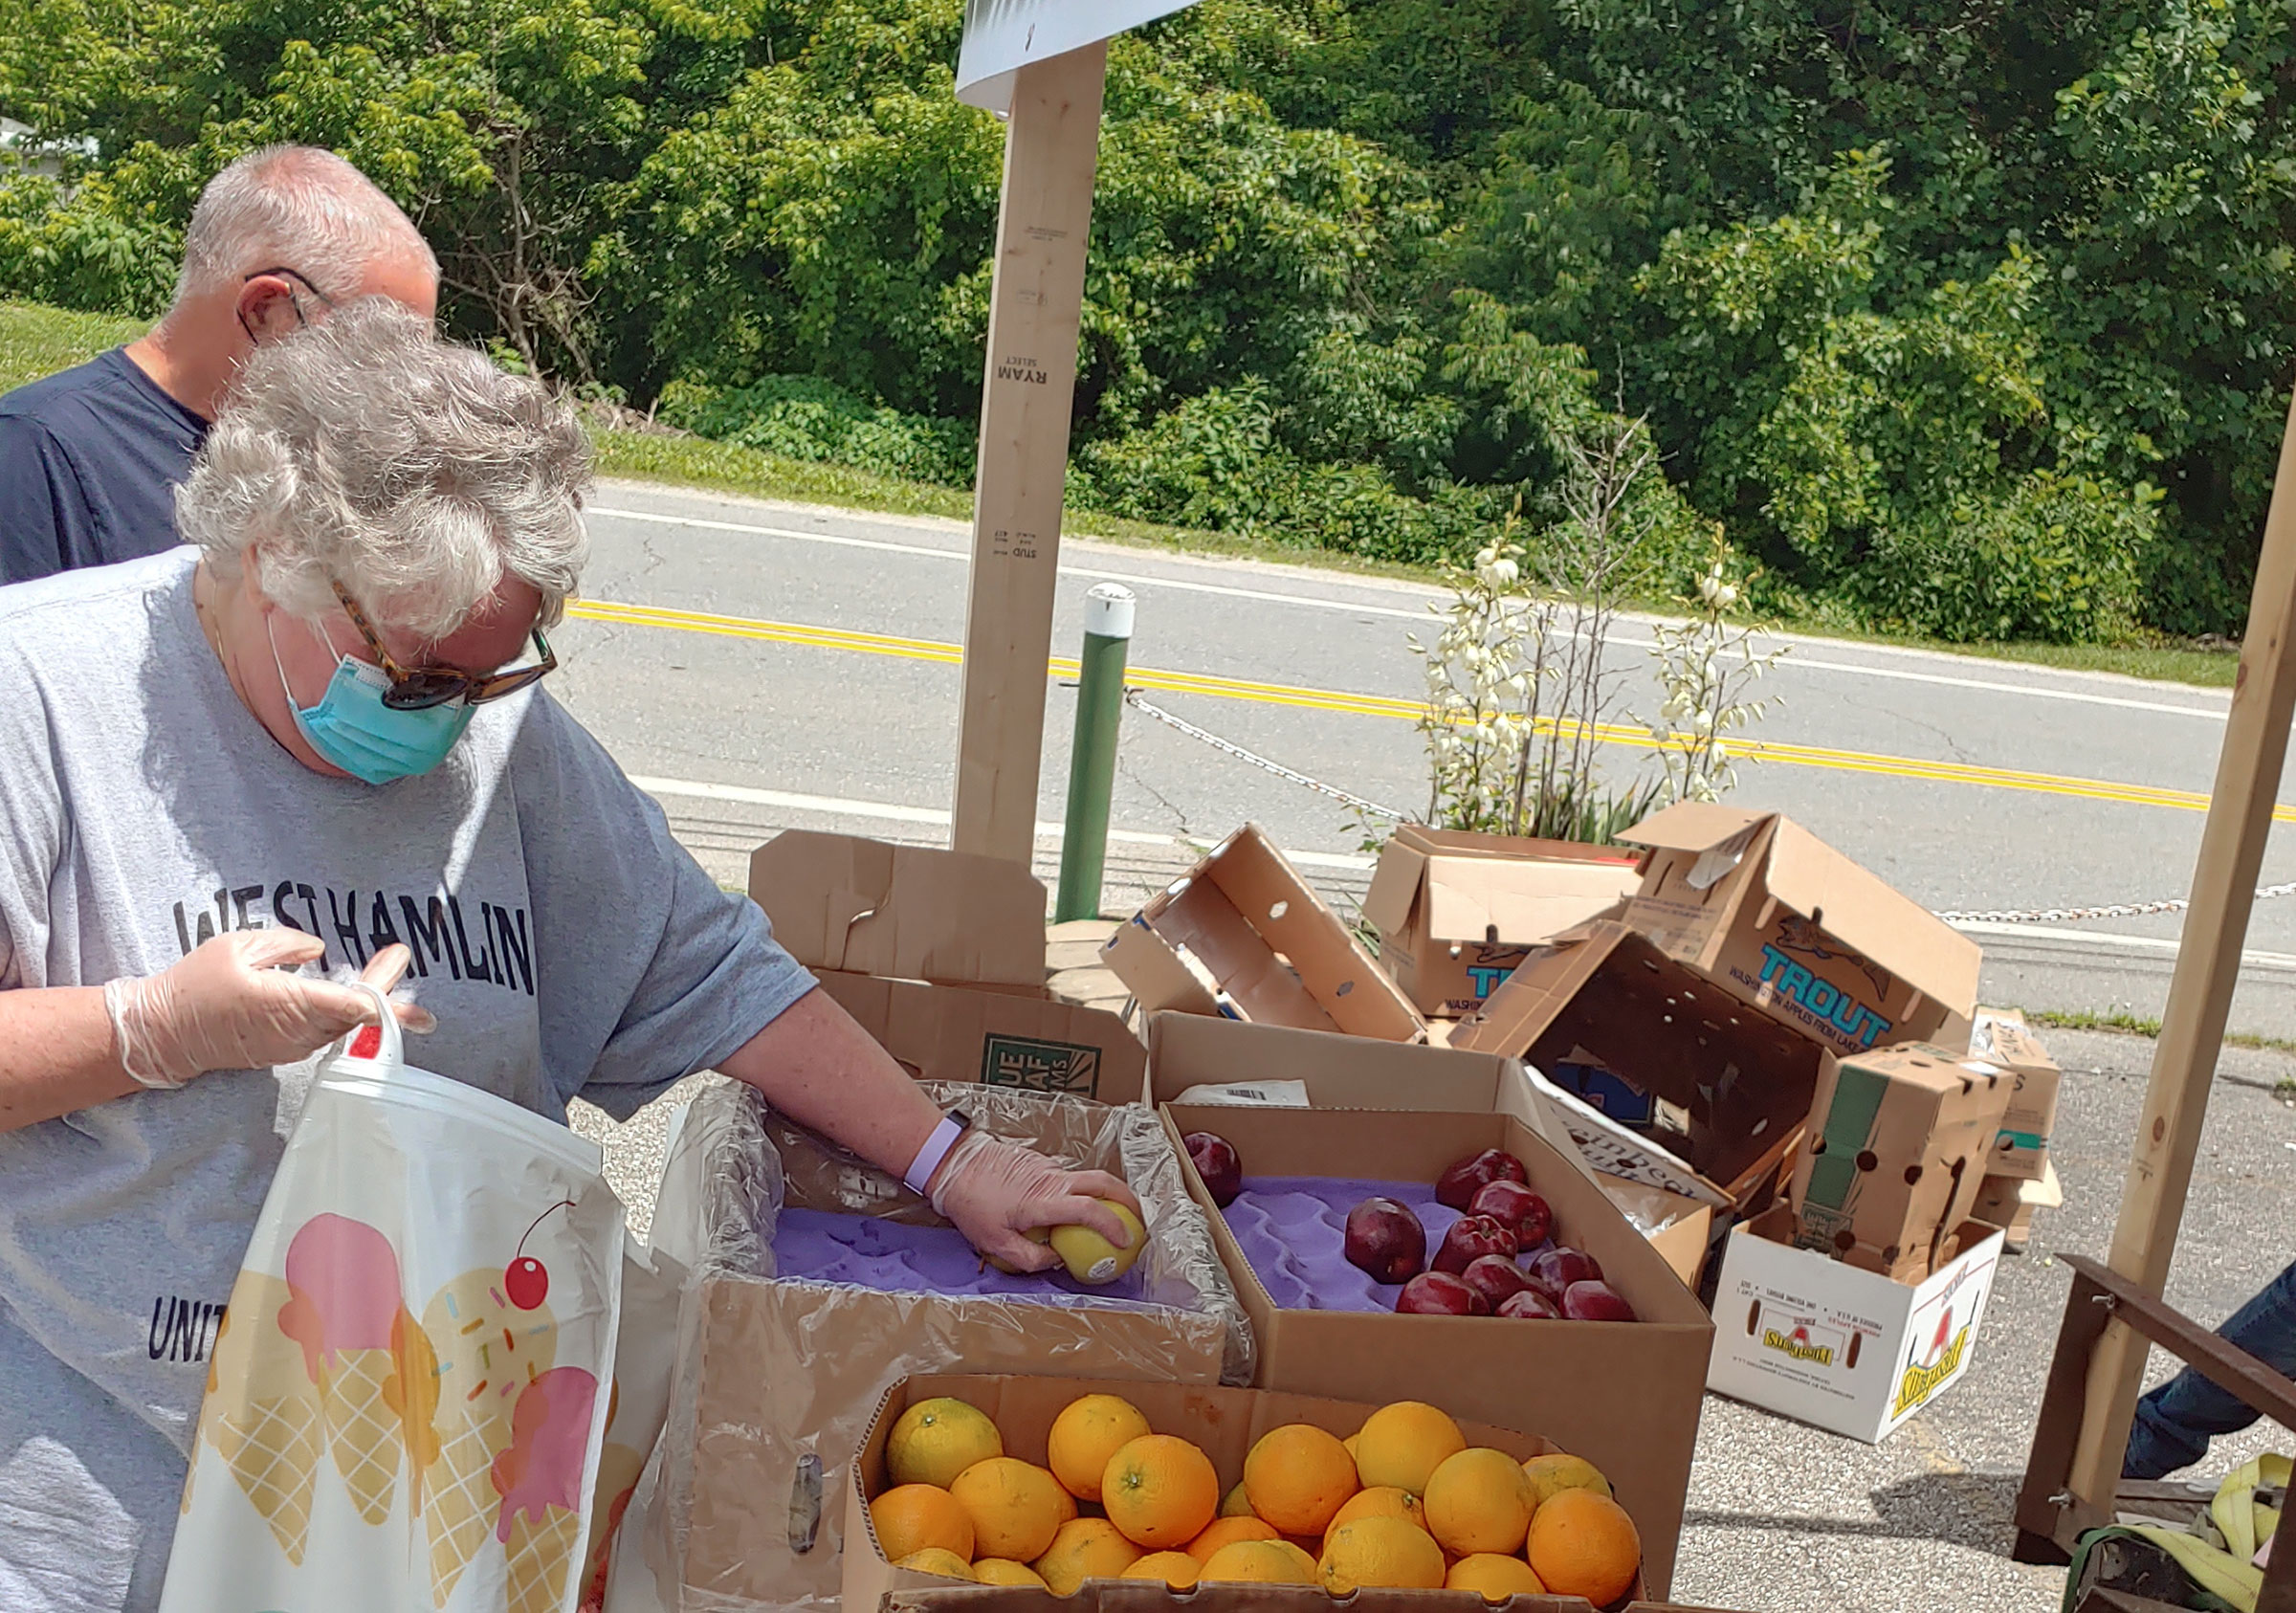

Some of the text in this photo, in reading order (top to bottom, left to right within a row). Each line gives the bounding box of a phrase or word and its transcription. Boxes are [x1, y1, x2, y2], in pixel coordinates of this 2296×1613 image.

[1006, 356, 1038, 367] SELECT
[998, 365, 1047, 385] RYAM
[1013, 547, 1037, 559] STUD
[1758, 941, 1893, 1050] TROUT
[1783, 999, 1814, 1027] APPLES
[1813, 1020, 1837, 1041] FROM
[1837, 1036, 1860, 1053] LAKE
